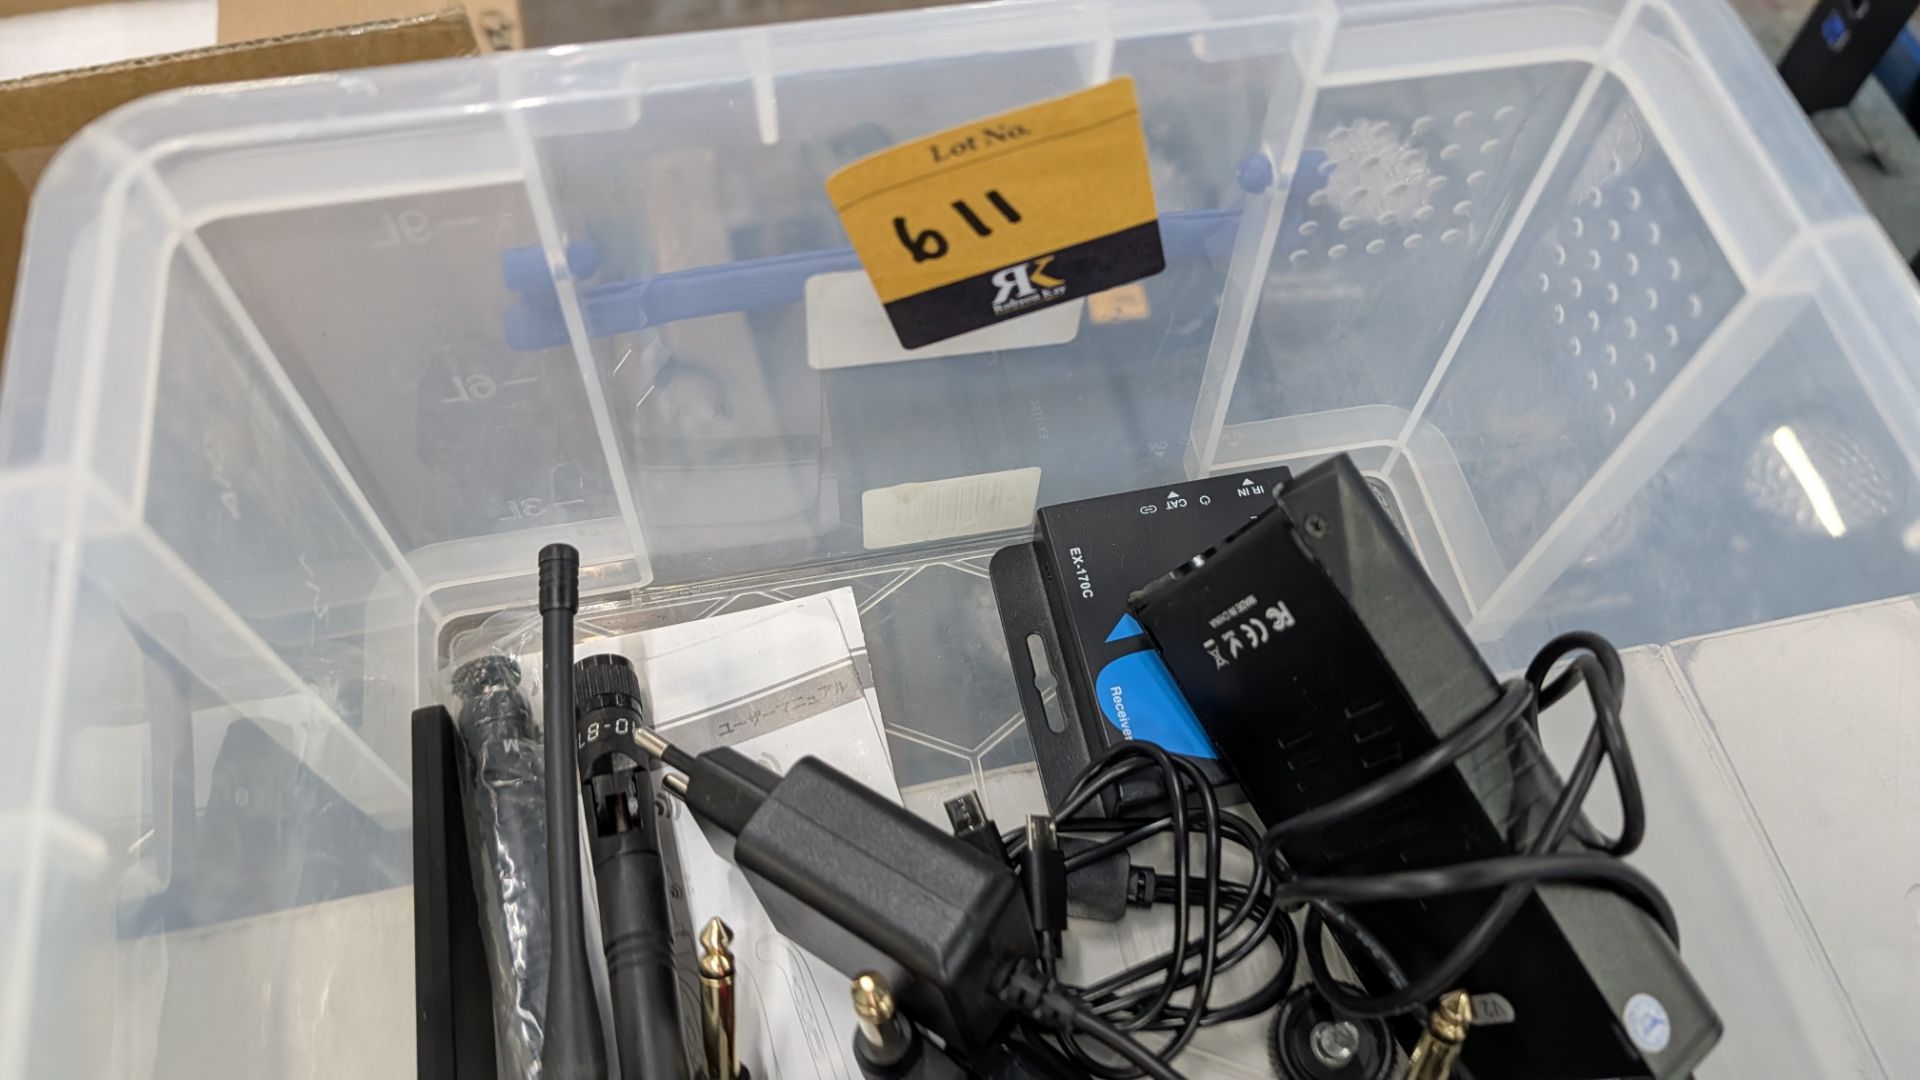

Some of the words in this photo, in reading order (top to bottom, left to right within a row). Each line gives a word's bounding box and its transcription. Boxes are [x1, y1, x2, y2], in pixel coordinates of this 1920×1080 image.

[929, 136, 978, 163] Lot
[892, 189, 1023, 263] 611
[1237, 487, 1250, 498] IN
[1252, 485, 1265, 495] IR
[1165, 498, 1188, 511] CAT
[1069, 547, 1094, 600] EX-170C
[1235, 594, 1258, 613] MADE
[1208, 610, 1232, 629] CHINA
[1110, 686, 1133, 740] Receiver
